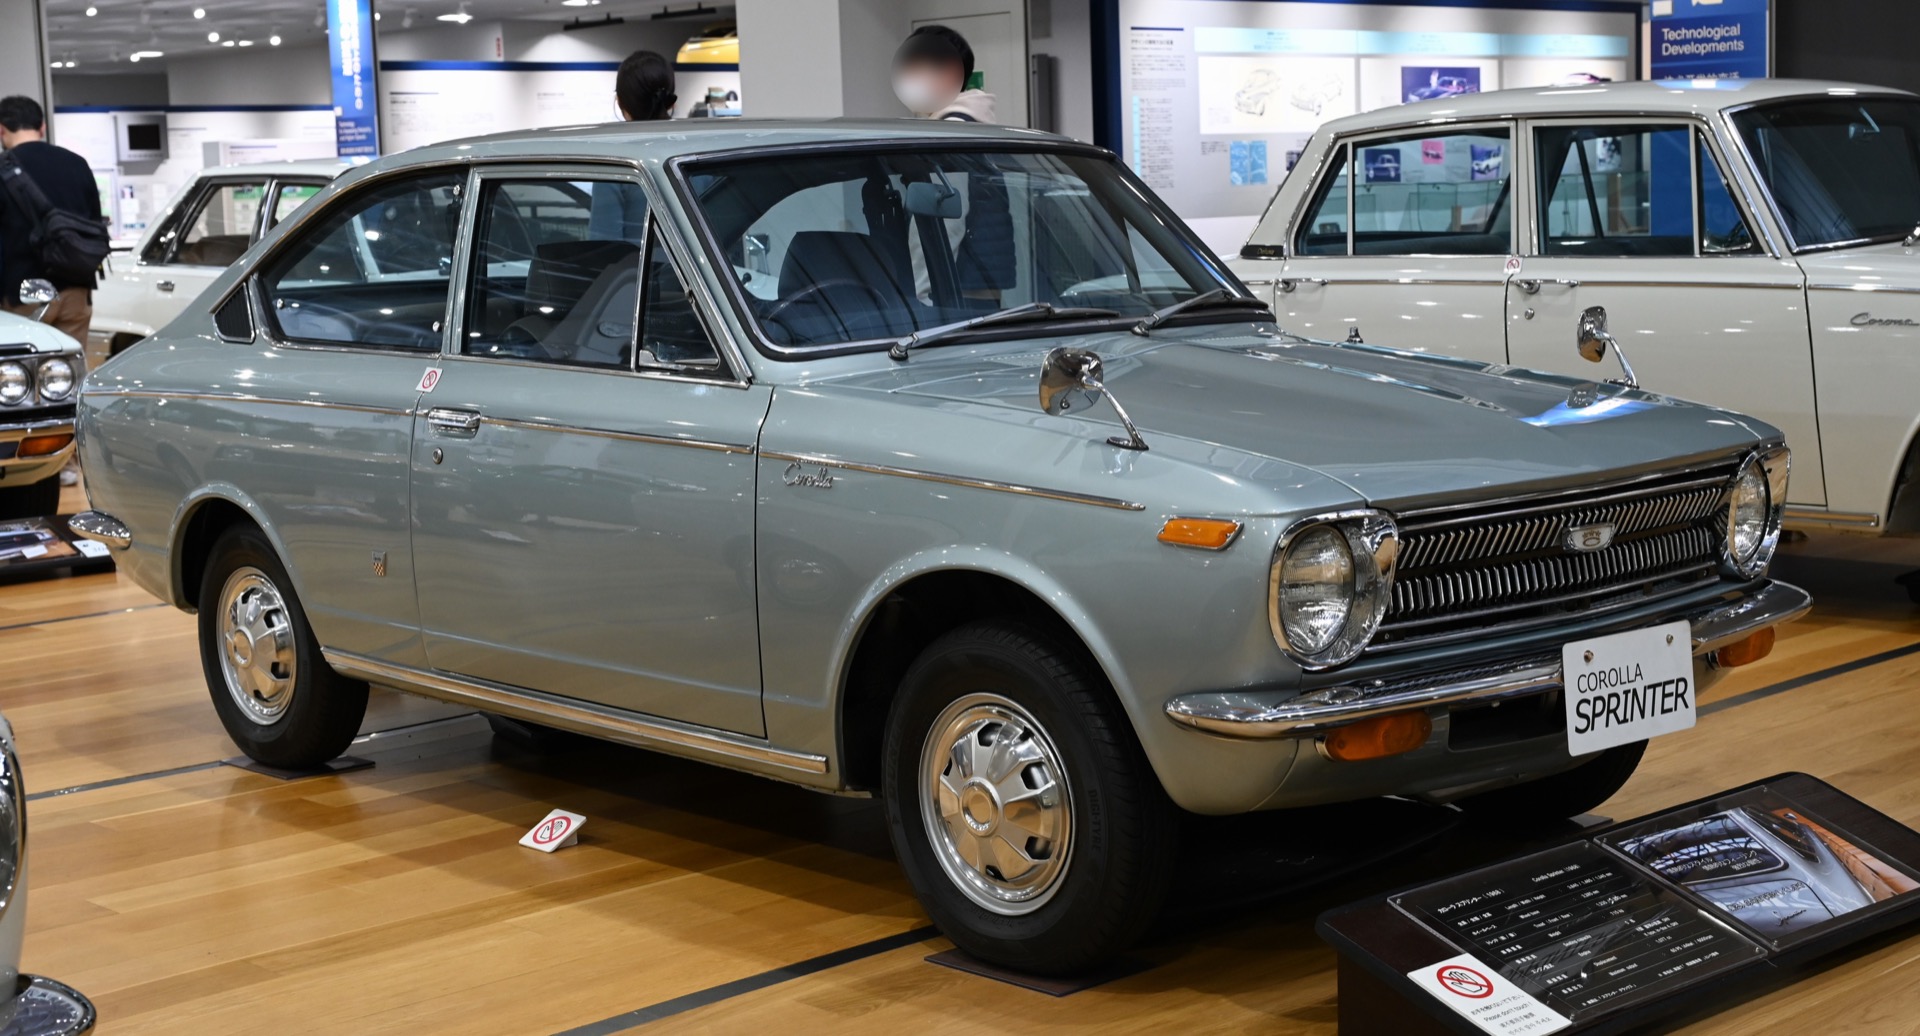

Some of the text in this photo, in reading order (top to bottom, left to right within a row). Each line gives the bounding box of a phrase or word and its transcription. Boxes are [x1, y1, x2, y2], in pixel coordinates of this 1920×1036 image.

[1661, 23, 1741, 40] Technological
[1661, 39, 1744, 56] Developments
[783, 462, 834, 489] Corolla
[1577, 663, 1643, 694] COROLLA
[1575, 677, 1689, 734] SPRINTER
